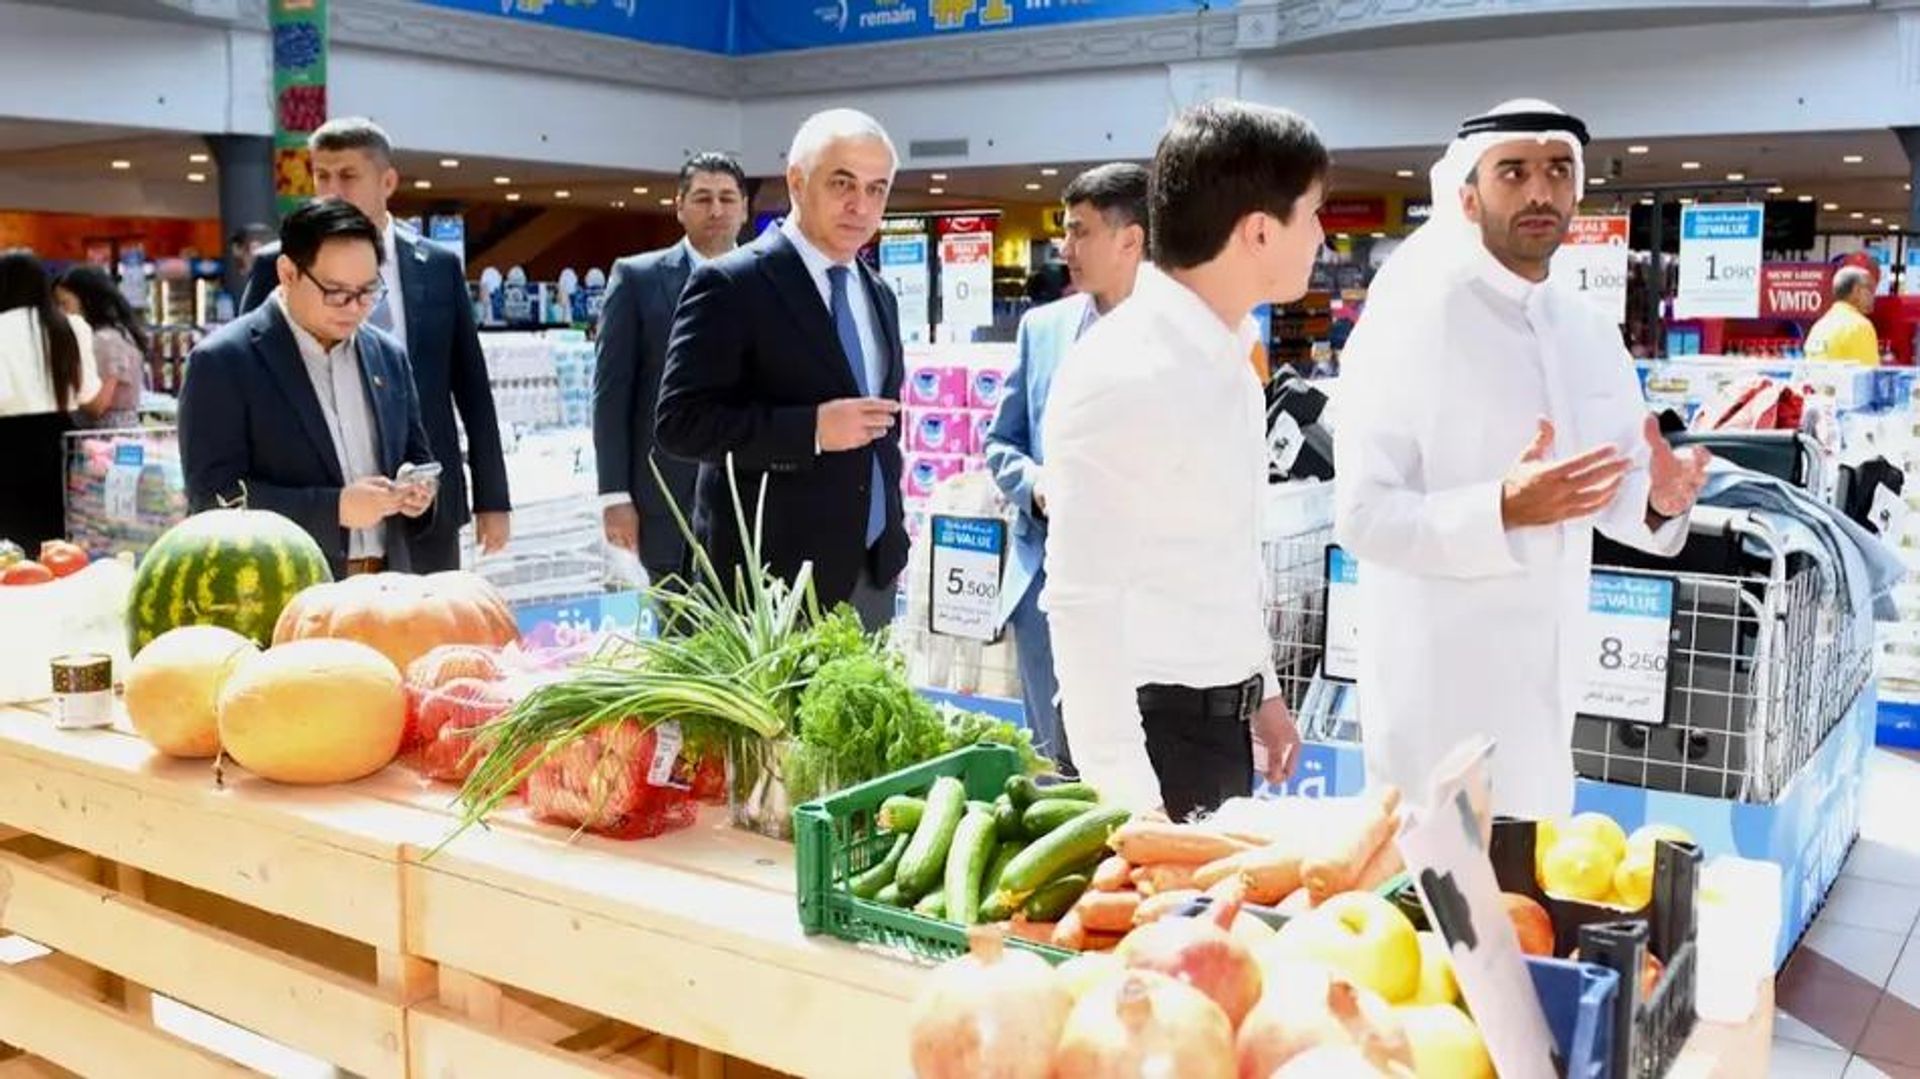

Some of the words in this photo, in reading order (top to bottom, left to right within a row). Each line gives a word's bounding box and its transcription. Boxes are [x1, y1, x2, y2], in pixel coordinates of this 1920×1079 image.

[859, 11, 917, 27] remain
[1768, 287, 1823, 313] VIMTO
[1608, 594, 1658, 611] VALUE
[1599, 636, 1667, 672] 8.250
